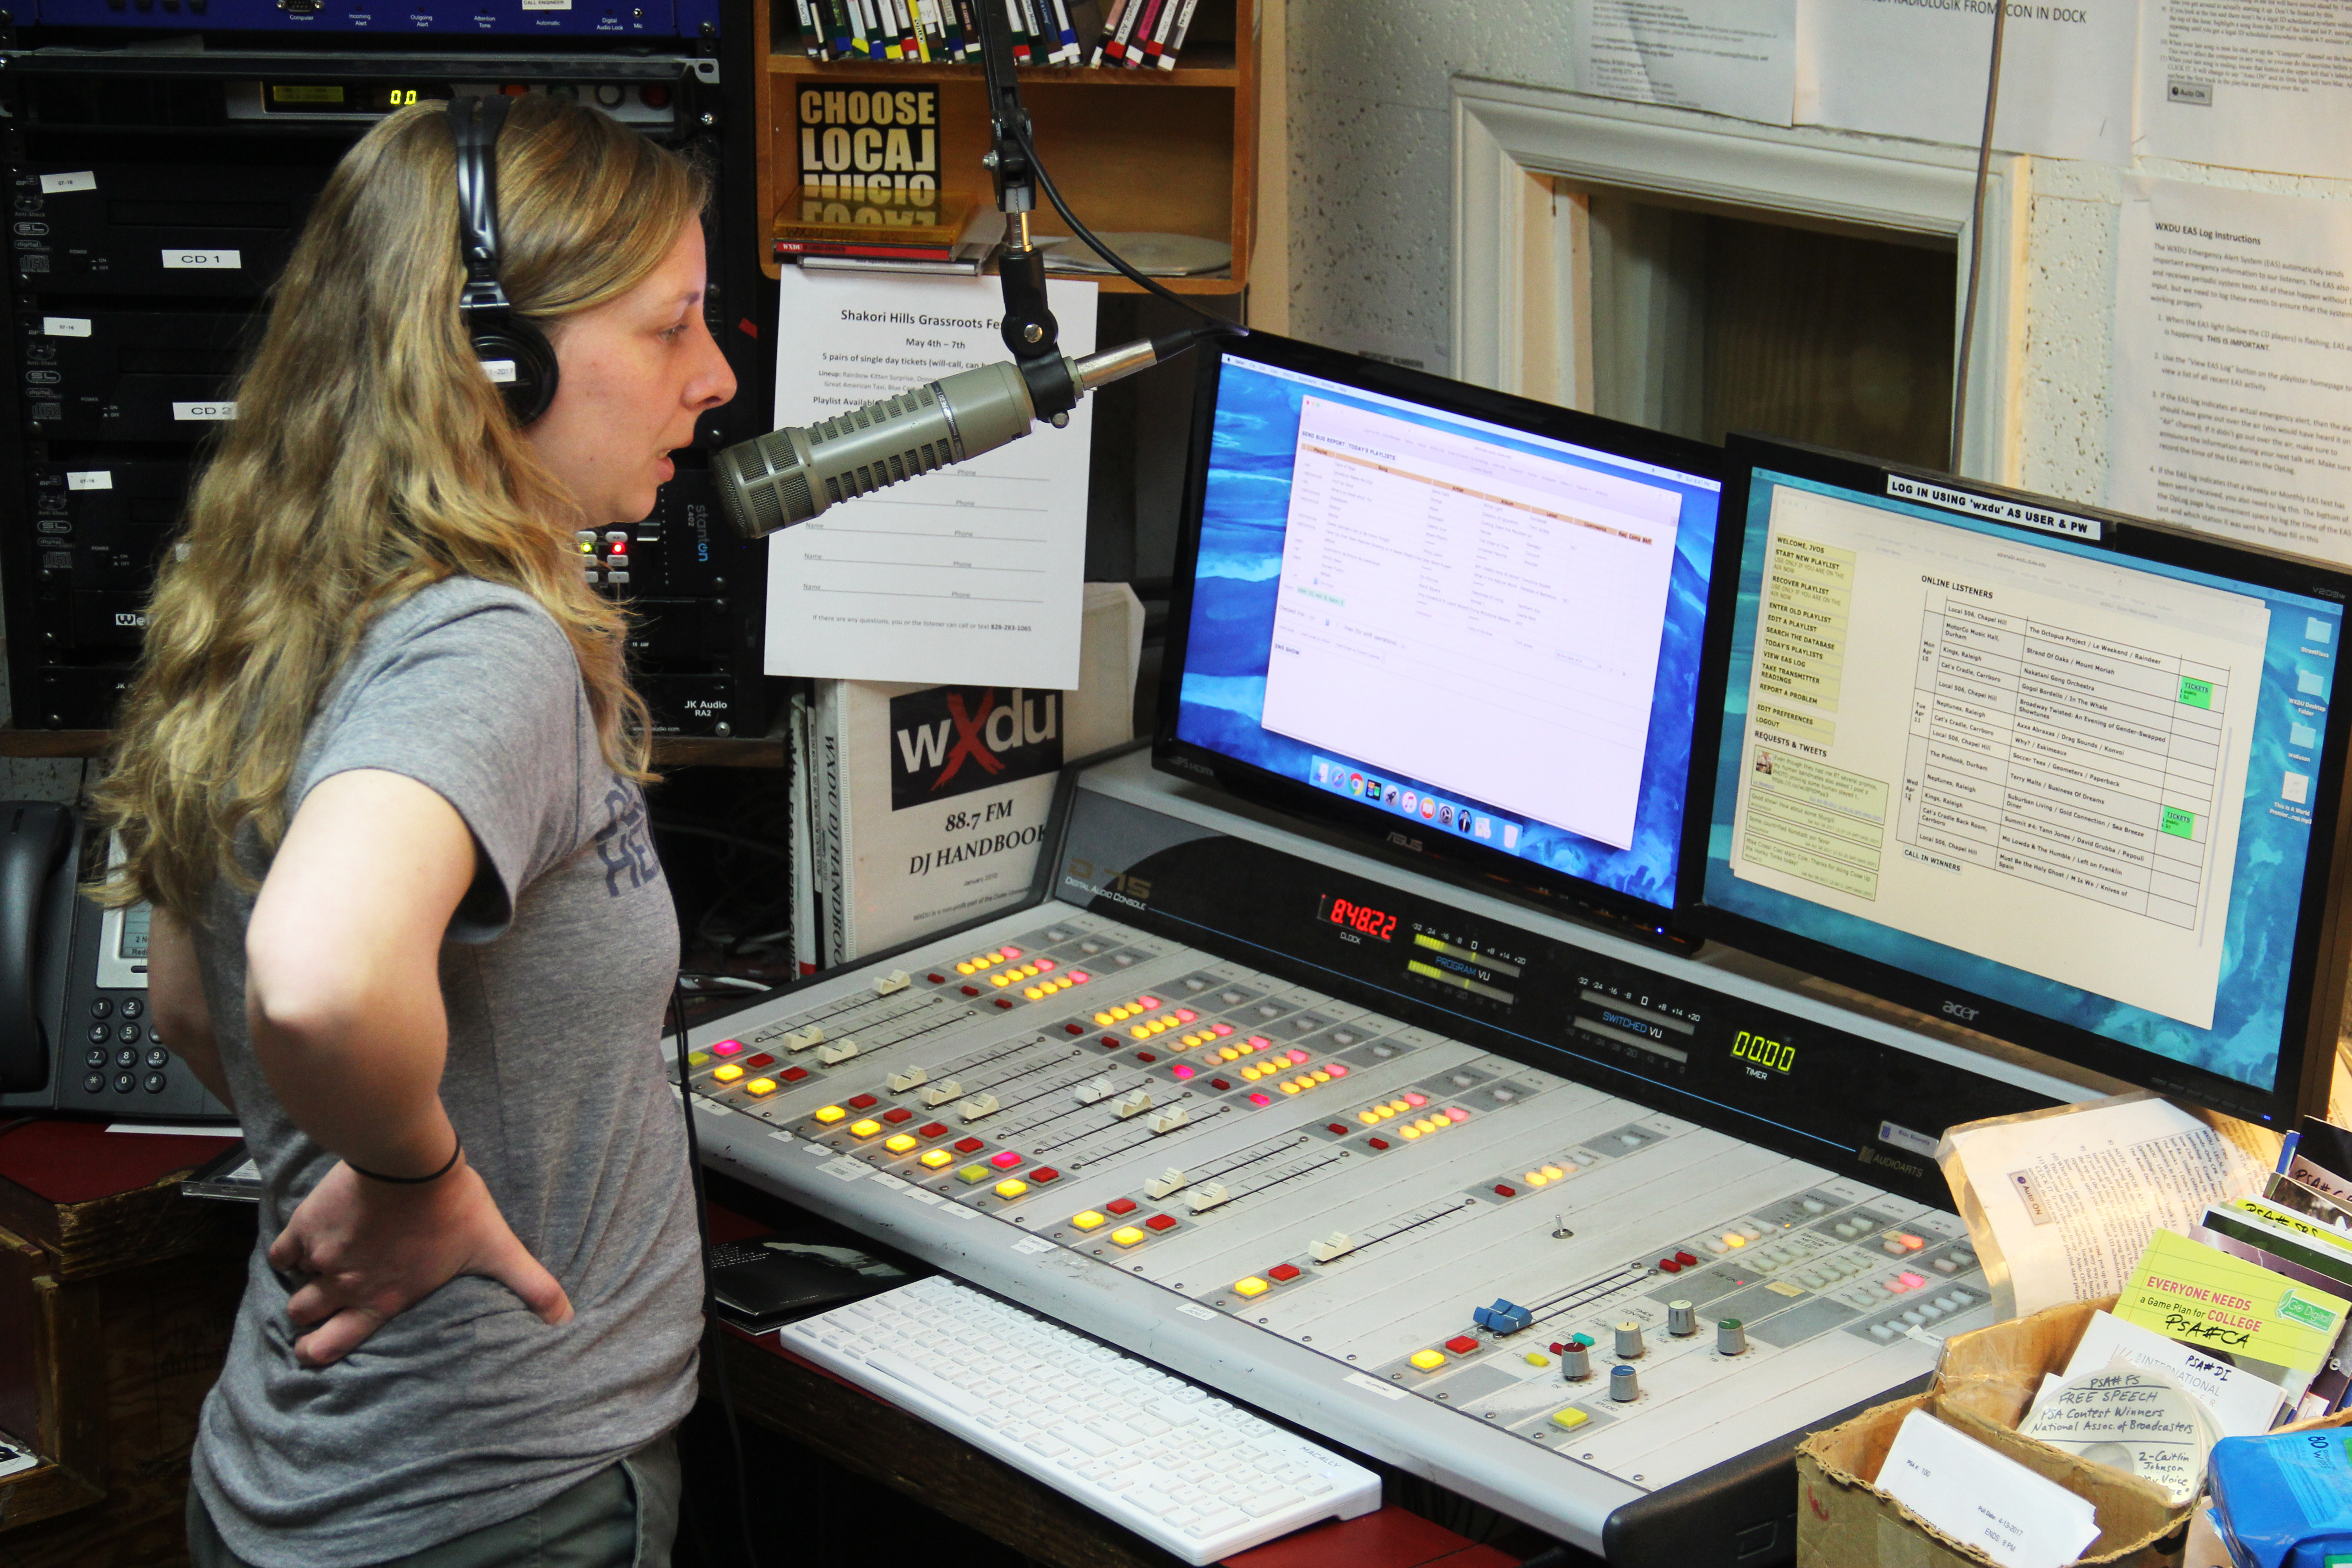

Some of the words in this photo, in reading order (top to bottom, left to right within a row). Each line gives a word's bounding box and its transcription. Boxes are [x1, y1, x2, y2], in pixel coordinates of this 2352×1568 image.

[1965, 2, 1996, 15] FROM
[2037, 6, 2048, 20] IN
[2053, 7, 2086, 23] DOCK
[800, 90, 935, 125] CHOOSE
[2156, 222, 2180, 233] WXDU
[2183, 226, 2197, 235] EAS
[2199, 228, 2213, 240] Log
[2215, 231, 2261, 245] Instructions
[841, 310, 886, 323] Shakori
[890, 313, 914, 324] Hills
[919, 314, 982, 329] Grassroots
[906, 339, 925, 348] May
[927, 339, 941, 348] 4th
[829, 354, 848, 363] pairs
[886, 357, 899, 365] day
[929, 359, 963, 368] (will-call,
[813, 397, 841, 407] Playlist
[1327, 438, 1345, 446] REPORT
[1349, 444, 1368, 453] TODAY'S
[1370, 449, 1395, 460] PLAYLISTS
[1892, 482, 1912, 494] LOG
[1917, 487, 1928, 497] IN
[1932, 491, 1966, 505] USING
[1970, 499, 2003, 514] 'wxdu'
[2007, 508, 2021, 518] AS
[2025, 511, 2054, 526] USER
[2071, 521, 2087, 533] PW
[696, 505, 710, 561] stanton
[1777, 537, 1808, 550] WELCOME,
[1809, 545, 1824, 553] JVOS
[1776, 549, 1795, 559] START
[1811, 558, 1840, 569] PLAYLIST
[1773, 576, 1799, 587] RECOVER
[1801, 583, 1829, 595] PLAYLIST
[1922, 575, 1950, 588] ONLINE
[1952, 583, 1994, 598] LISTENERS
[1769, 603, 1788, 612] ENTER
[1803, 611, 1832, 623] PLAYLIST
[1978, 613, 1996, 623] Chapel
[1766, 627, 1789, 637] SEARCH
[1803, 637, 1835, 650] DATABASE
[2041, 630, 2064, 641] Octopus
[2066, 636, 2086, 647] Project
[2101, 645, 2128, 656] Weekend
[2135, 653, 2161, 664] Raindeer
[1764, 652, 1779, 660] VIEW
[2185, 682, 2209, 693] TICKETS
[1756, 716, 1779, 728] LOGOUT
[1757, 705, 1771, 713] EDIT
[1773, 708, 1813, 725] PREFERENCES
[1755, 731, 1790, 746] REQUESTS
[1799, 743, 1827, 757] TWEETS
[826, 736, 837, 811] WXDU
[945, 813, 980, 831] 88.7
[985, 800, 1014, 822] FM
[827, 814, 839, 838] DJ
[1387, 832, 1422, 852] ASUS
[910, 854, 932, 875] DJ
[1905, 849, 1919, 858] CALL
[1931, 858, 1960, 871] WINNERS
[1340, 932, 1361, 944] CLOCK
[1436, 956, 1477, 975] PROGRAM
[1479, 970, 1490, 981] VU
[1942, 1000, 1979, 1020] acer
[1602, 1012, 1647, 1033] SWITCHED
[1650, 1027, 1662, 1038] VU
[1746, 1067, 1767, 1080] TIMER
[1873, 1154, 1922, 1177] AUDIOARTS
[2147, 1276, 2208, 1301] EVERYONE
[2211, 1293, 2252, 1311] NEEDS
[2148, 1297, 2171, 1310] Game
[2173, 1303, 2191, 1314] Plan
[2193, 1307, 2205, 1317] for
[2208, 1309, 2262, 1332] COLLEGE
[2165, 1314, 2251, 1349] PSA#CA
[2090, 1376, 2122, 1388] PSA#
[2125, 1376, 2140, 1386] FS
[2059, 1392, 2097, 1405] FREE
[2102, 1392, 2158, 1402] SPEECH
[2042, 1408, 2063, 1420] PSA
[2067, 1408, 2112, 1419] Contest
[2114, 1408, 2164, 1418] Winners
[2031, 1423, 2079, 1434] National
[2083, 1420, 2116, 1431] Assoc.
[2118, 1420, 2127, 1431] of
[2130, 1420, 2194, 1434] Broadcasters
[2308, 1436, 2328, 1449] 80
[1921, 1468, 1931, 1477] 100
[2143, 1461, 2184, 1471] Johnson
[2161, 1474, 2188, 1486] Voice
[1985, 1511, 1996, 1520] Date:
[1998, 1518, 2023, 1536] 4-13-2017
[1984, 1528, 2001, 1544] ENDS:
[2007, 1542, 2016, 1552] PM
